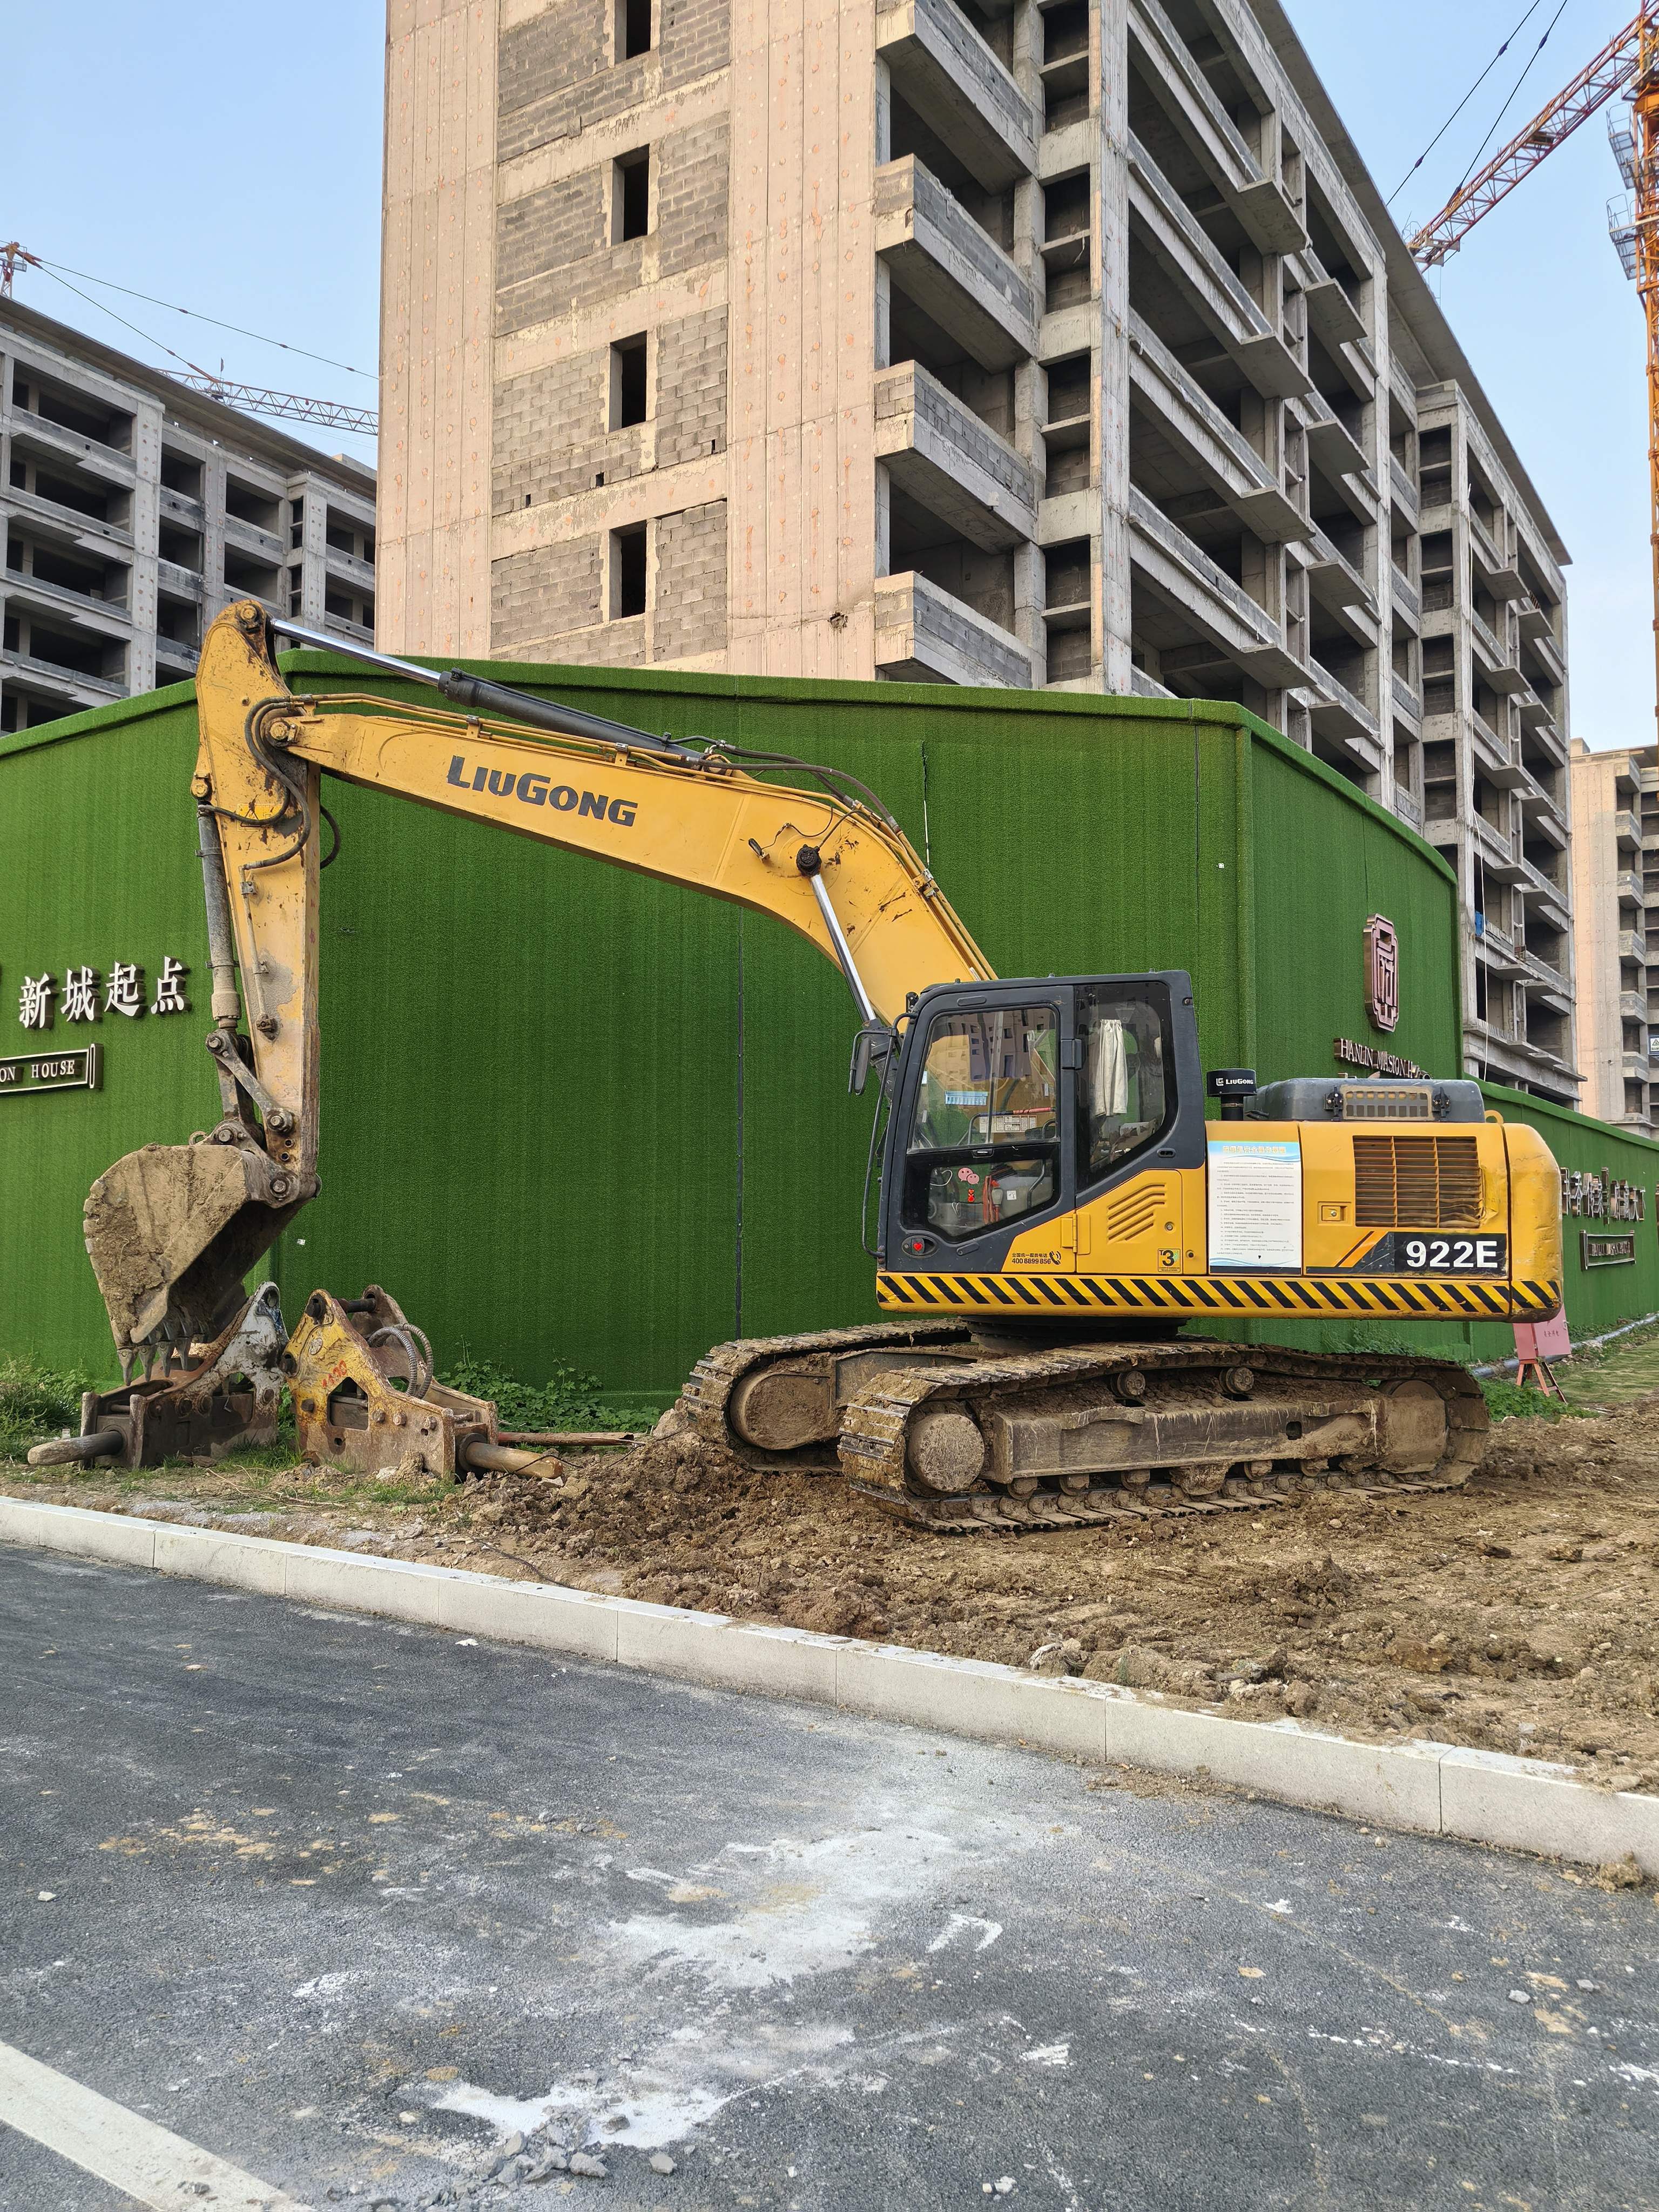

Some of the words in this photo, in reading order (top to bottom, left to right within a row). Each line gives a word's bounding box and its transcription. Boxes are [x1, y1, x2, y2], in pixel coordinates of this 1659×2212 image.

[18, 955, 184, 1028] 新城起点
[1340, 1038, 1373, 1068] HANLIN
[31, 1060, 75, 1078] HOUSE
[1406, 1240, 1498, 1267] 922E
